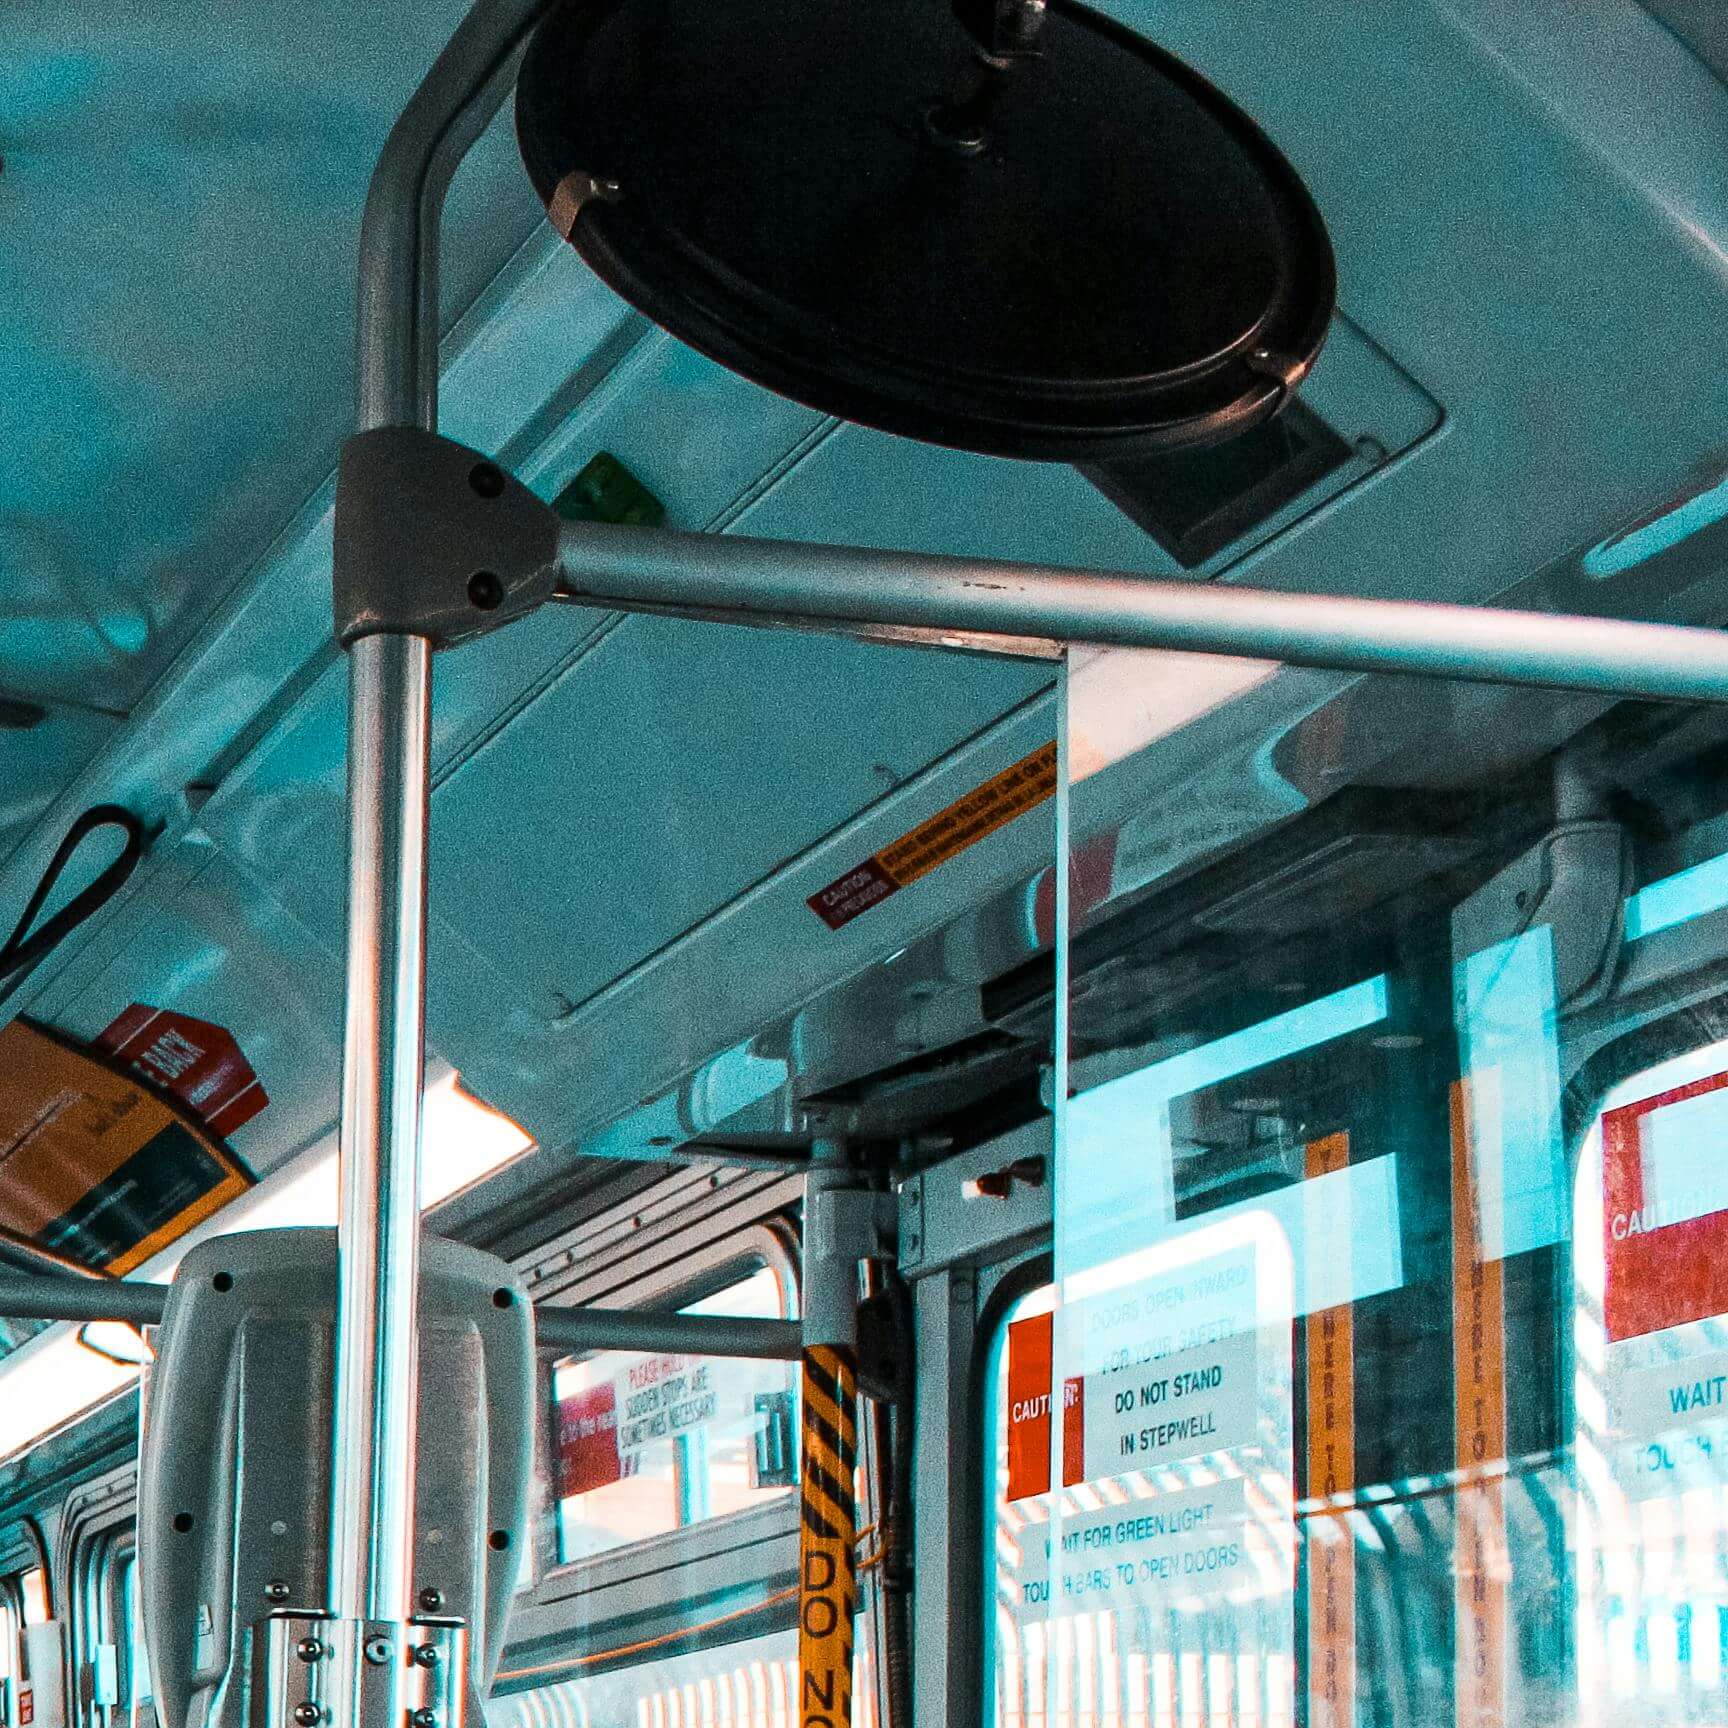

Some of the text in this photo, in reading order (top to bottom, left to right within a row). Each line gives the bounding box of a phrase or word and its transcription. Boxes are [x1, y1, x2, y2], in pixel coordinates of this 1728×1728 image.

[821, 868, 874, 907] CAUTION
[141, 1028, 206, 1079] BACK
[1013, 1383, 1081, 1424] CAUTIN:
[1115, 1365, 1223, 1414] DO NOT STAND
[1669, 1377, 1728, 1414] WAIT
[1120, 1413, 1217, 1456] IN STEPWELL
[1084, 1526, 1112, 1551] FOR
[1116, 1514, 1165, 1543] GREEN
[1170, 1504, 1215, 1533] LIGHT
[801, 1548, 839, 1641] DO
[1023, 1575, 1072, 1605] TOUH
[1116, 1564, 1135, 1587] TO
[1140, 1555, 1181, 1584] OPEN
[1185, 1544, 1239, 1574] DOORS
